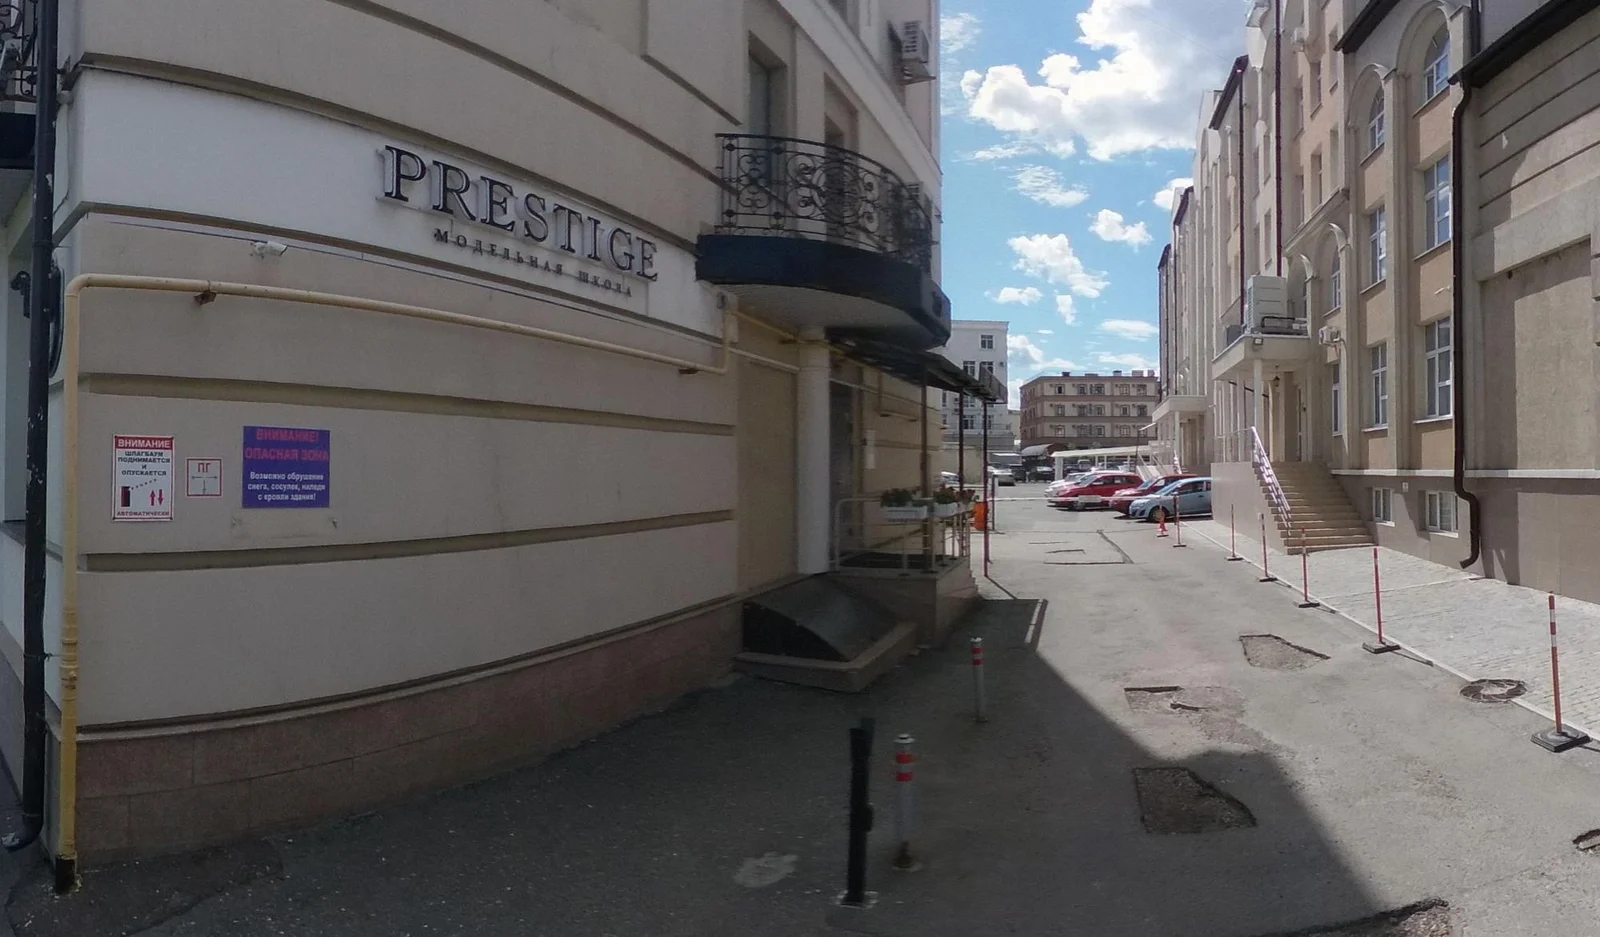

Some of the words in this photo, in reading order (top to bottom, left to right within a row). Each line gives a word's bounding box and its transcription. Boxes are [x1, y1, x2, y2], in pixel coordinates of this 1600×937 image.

[383, 144, 659, 282] PRESTIGE
[434, 228, 563, 276] МОДЕЛЬНАЯ
[577, 270, 632, 298] ШКОЛА
[256, 428, 319, 443] ВНИМАНИЕ!
[117, 438, 171, 448] ВНИМАНИЕ
[245, 447, 299, 460] ОПАСНАЯ
[301, 448, 329, 461] ЗОНА
[197, 462, 211, 473] ПГ
[250, 471, 286, 480] Возможно
[287, 472, 324, 481] обрушение
[264, 493, 289, 502] кровли
